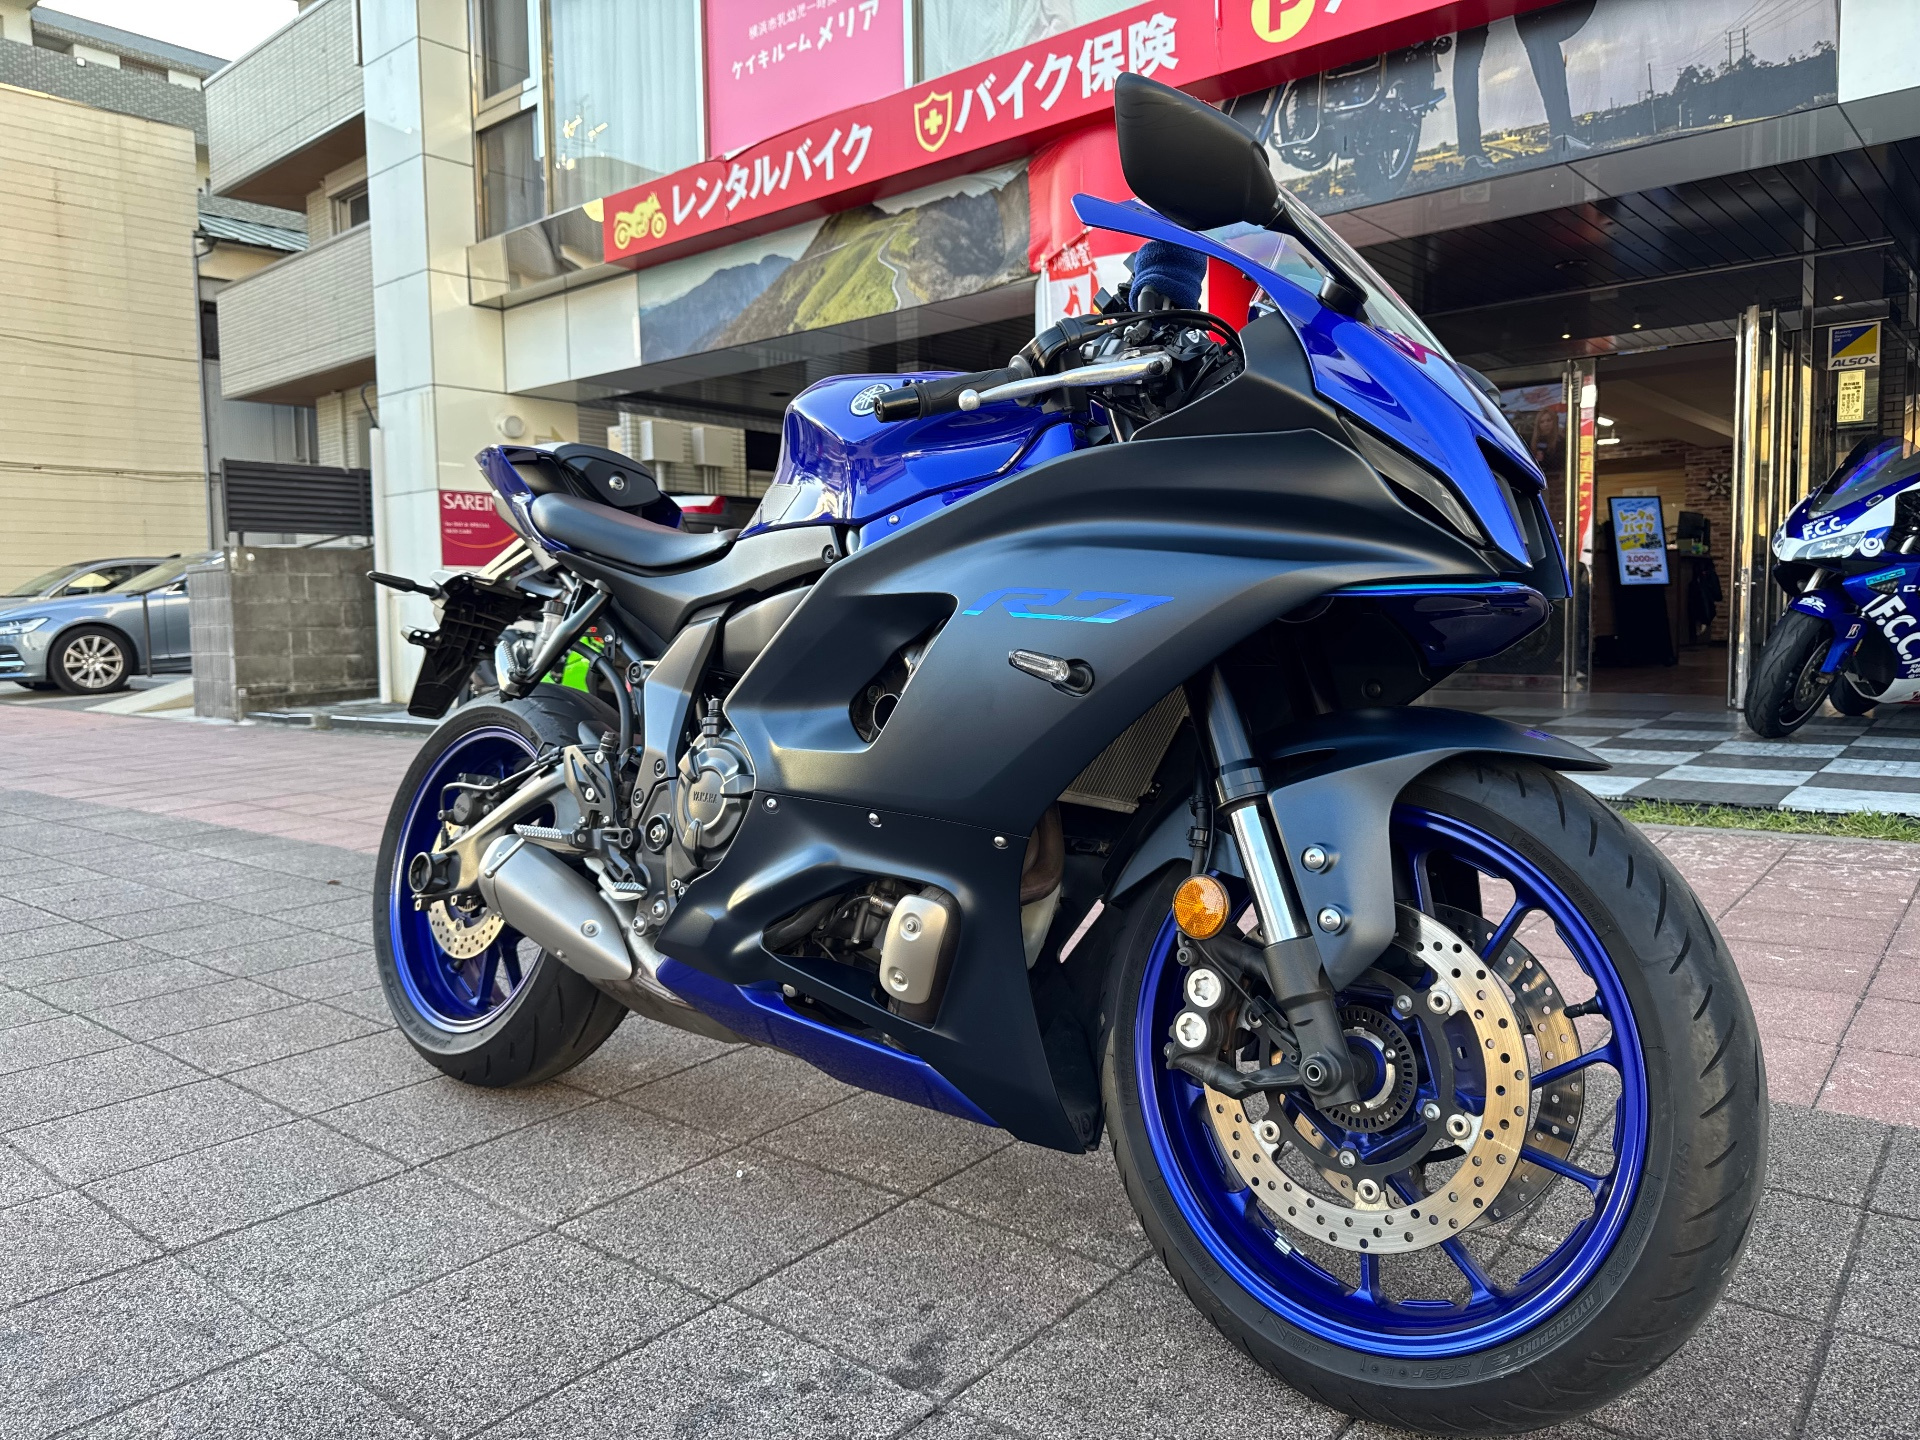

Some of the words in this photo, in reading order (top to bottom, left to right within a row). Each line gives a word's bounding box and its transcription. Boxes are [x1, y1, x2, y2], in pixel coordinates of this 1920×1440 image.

[954, 11, 1179, 133] バイク保険
[672, 122, 873, 226] レンタルバイク
[1831, 355, 1876, 368] ALSOK
[1802, 516, 1847, 541] F.C.C.
[961, 587, 1175, 624] R7
[693, 790, 718, 804] YAMAHA
[1515, 1293, 1596, 1359] HYPERSPORT
